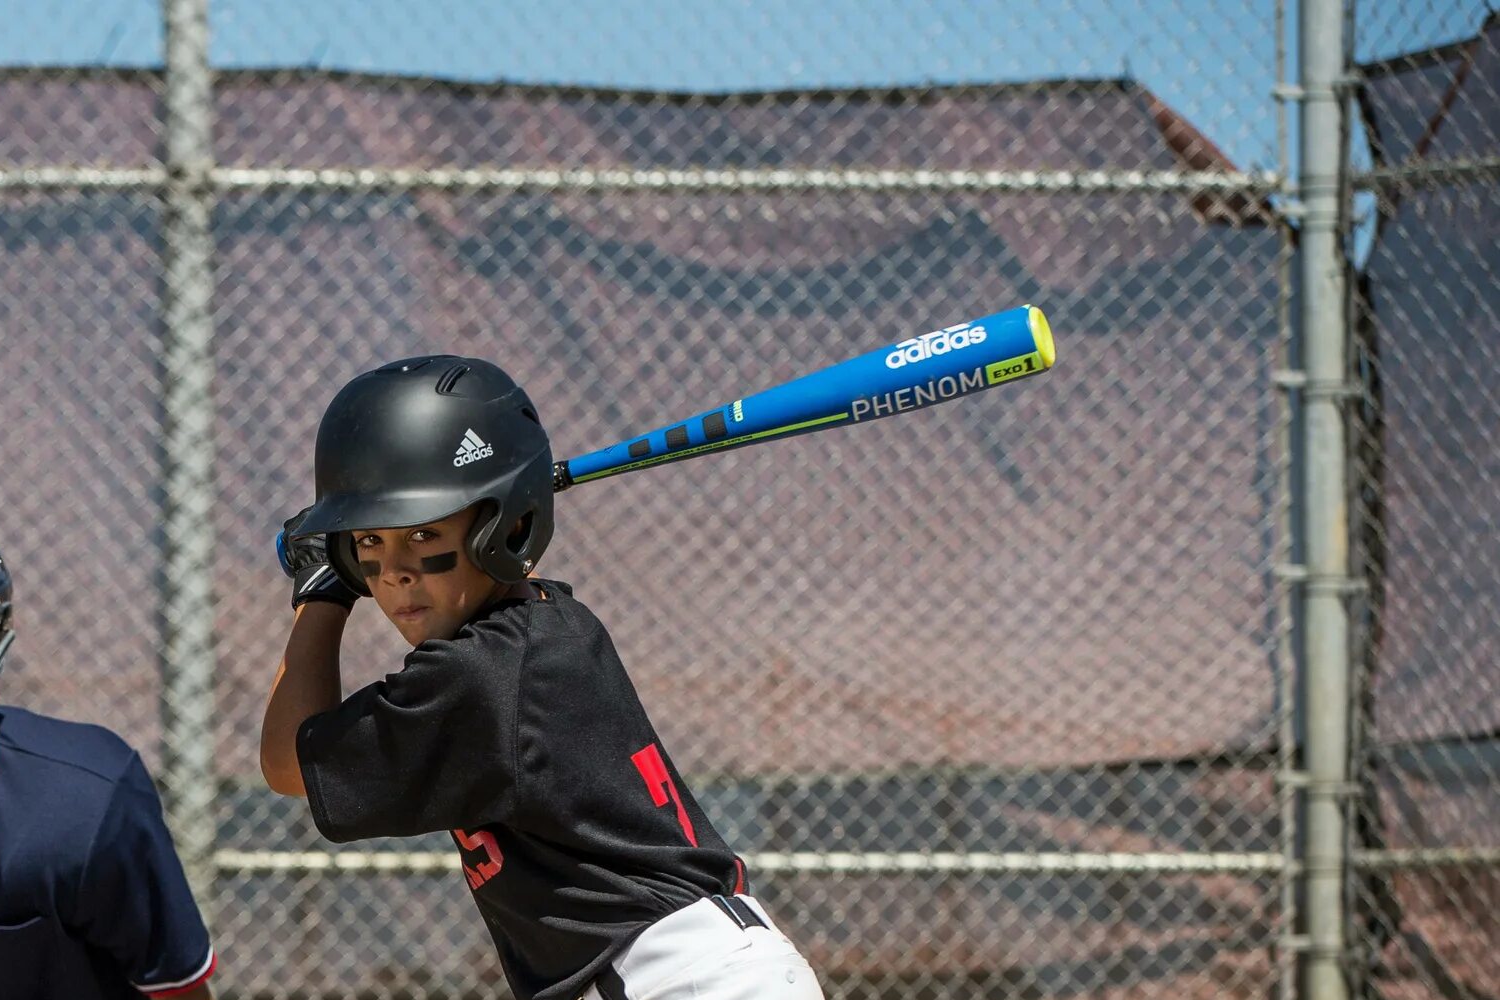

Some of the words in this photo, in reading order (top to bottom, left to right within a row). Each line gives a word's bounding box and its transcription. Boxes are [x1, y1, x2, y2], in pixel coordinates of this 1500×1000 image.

[886, 325, 987, 369] adidas
[852, 367, 984, 421] PHENOM
[453, 446, 493, 467] adidas
